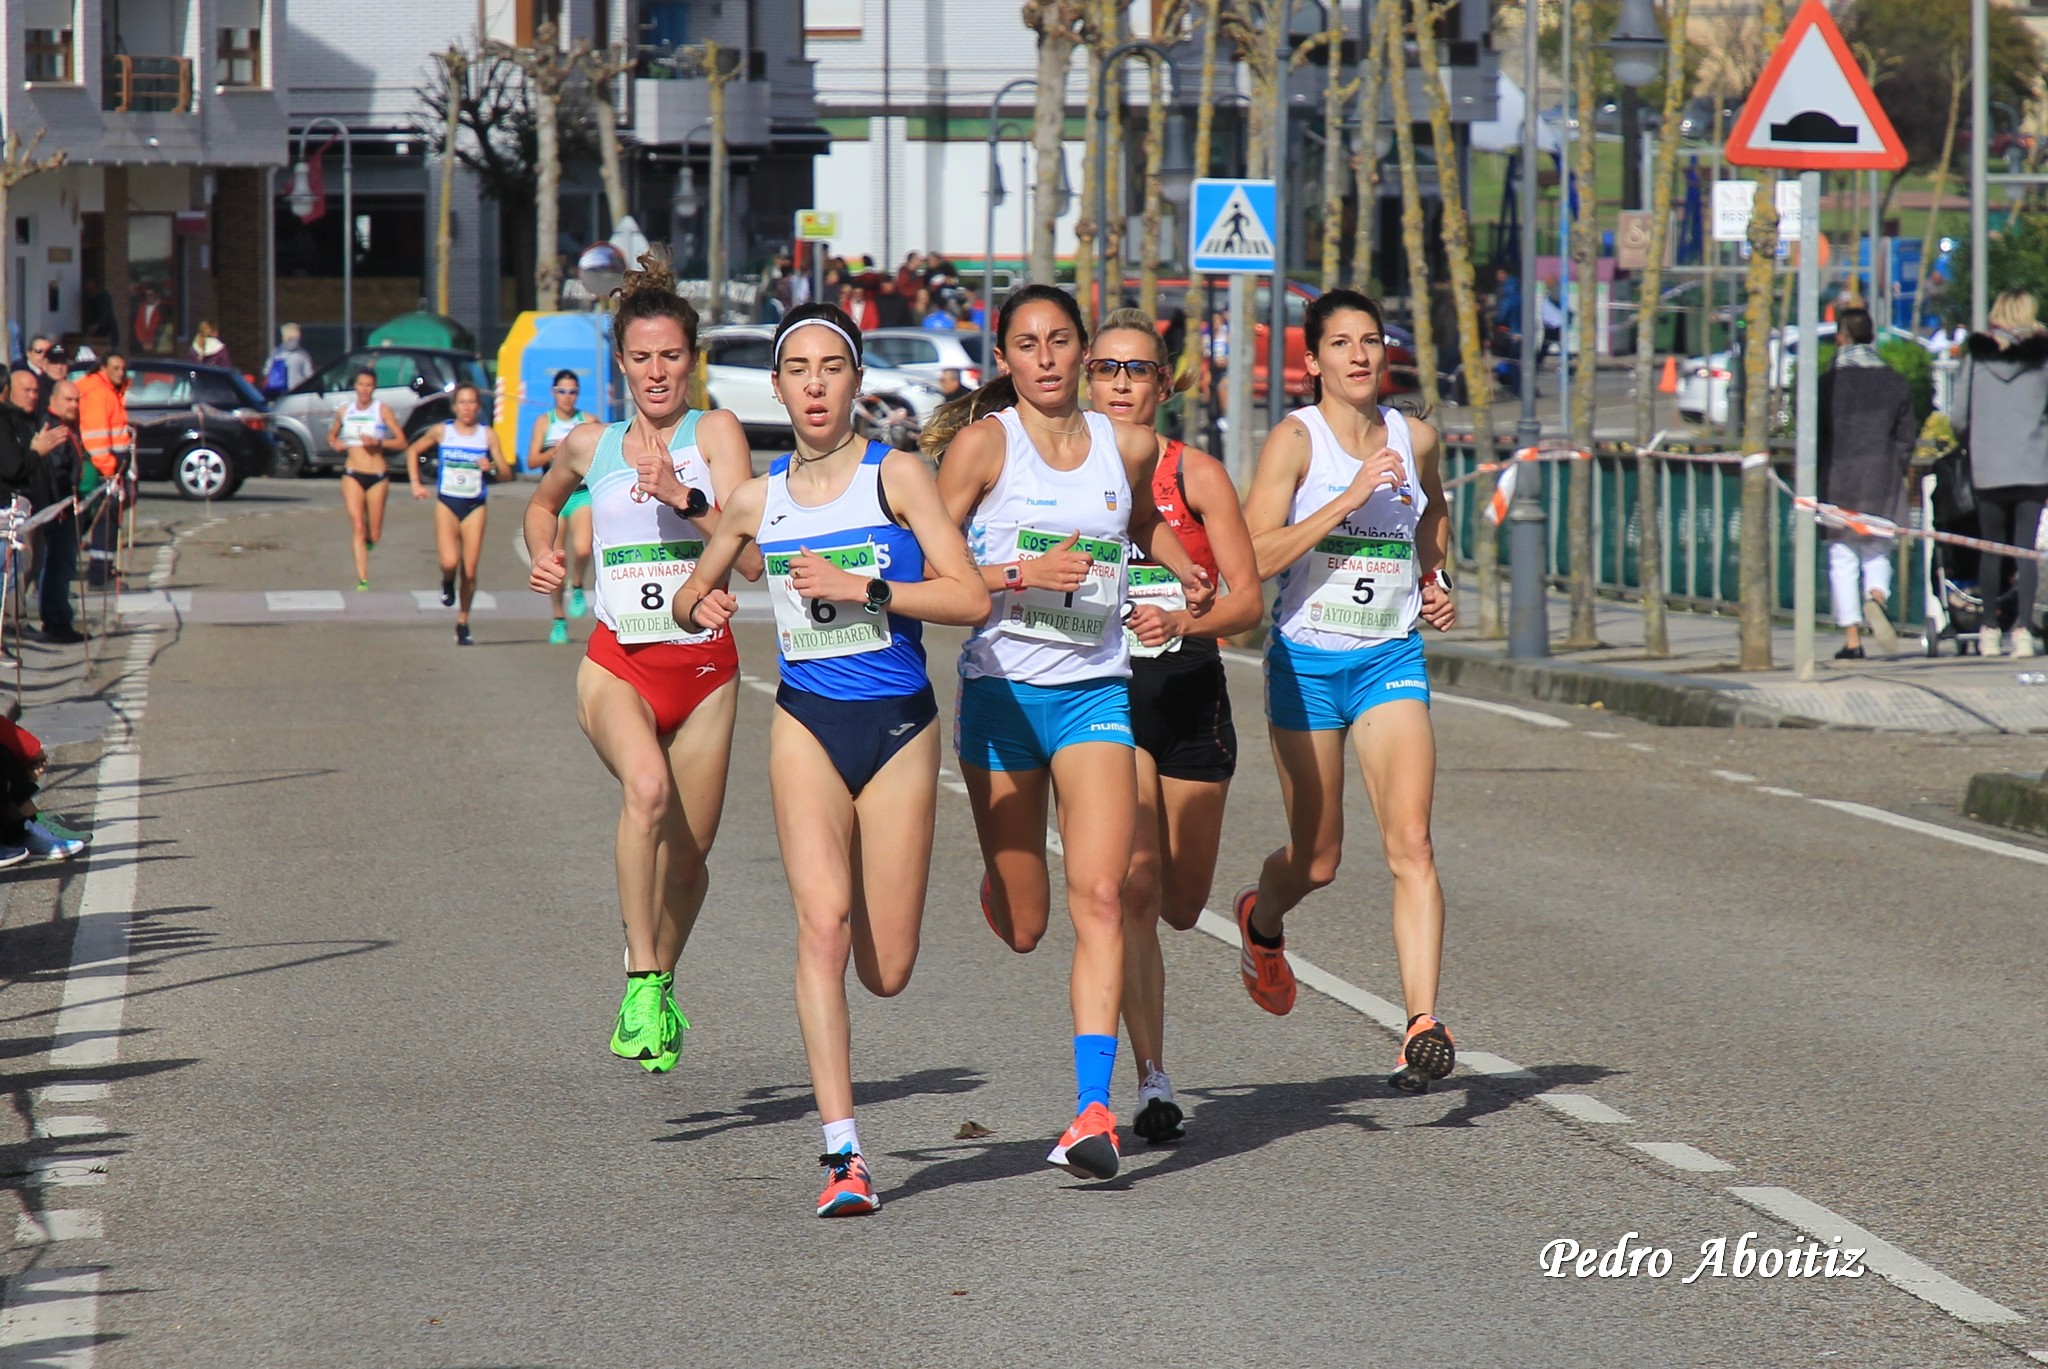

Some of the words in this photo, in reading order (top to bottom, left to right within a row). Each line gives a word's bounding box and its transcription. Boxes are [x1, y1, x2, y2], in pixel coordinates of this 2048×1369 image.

[606, 549, 643, 566] COSTA
[651, 547, 666, 561] DE
[673, 544, 699, 560] AJO
[1097, 546, 1118, 561] AJO
[1369, 544, 1383, 557] DE
[1389, 544, 1408, 559] AJO
[611, 567, 645, 581] CLARA
[647, 562, 695, 578] VIÑARAS
[768, 559, 789, 574] COS
[841, 551, 868, 566] AJO
[1327, 557, 1364, 573] ELENA
[641, 582, 665, 610] 8
[1352, 577, 1375, 605] 5
[811, 598, 837, 624] 6
[1025, 610, 1054, 627] AYTO
[1055, 614, 1069, 631] DE
[1323, 607, 1352, 624] AYTO
[1353, 611, 1366, 626] DE
[619, 618, 646, 633] AYTO
[648, 616, 661, 632] DE
[793, 630, 818, 649] AYTO
[820, 631, 835, 646] DE
[836, 624, 880, 645] BAREYO
